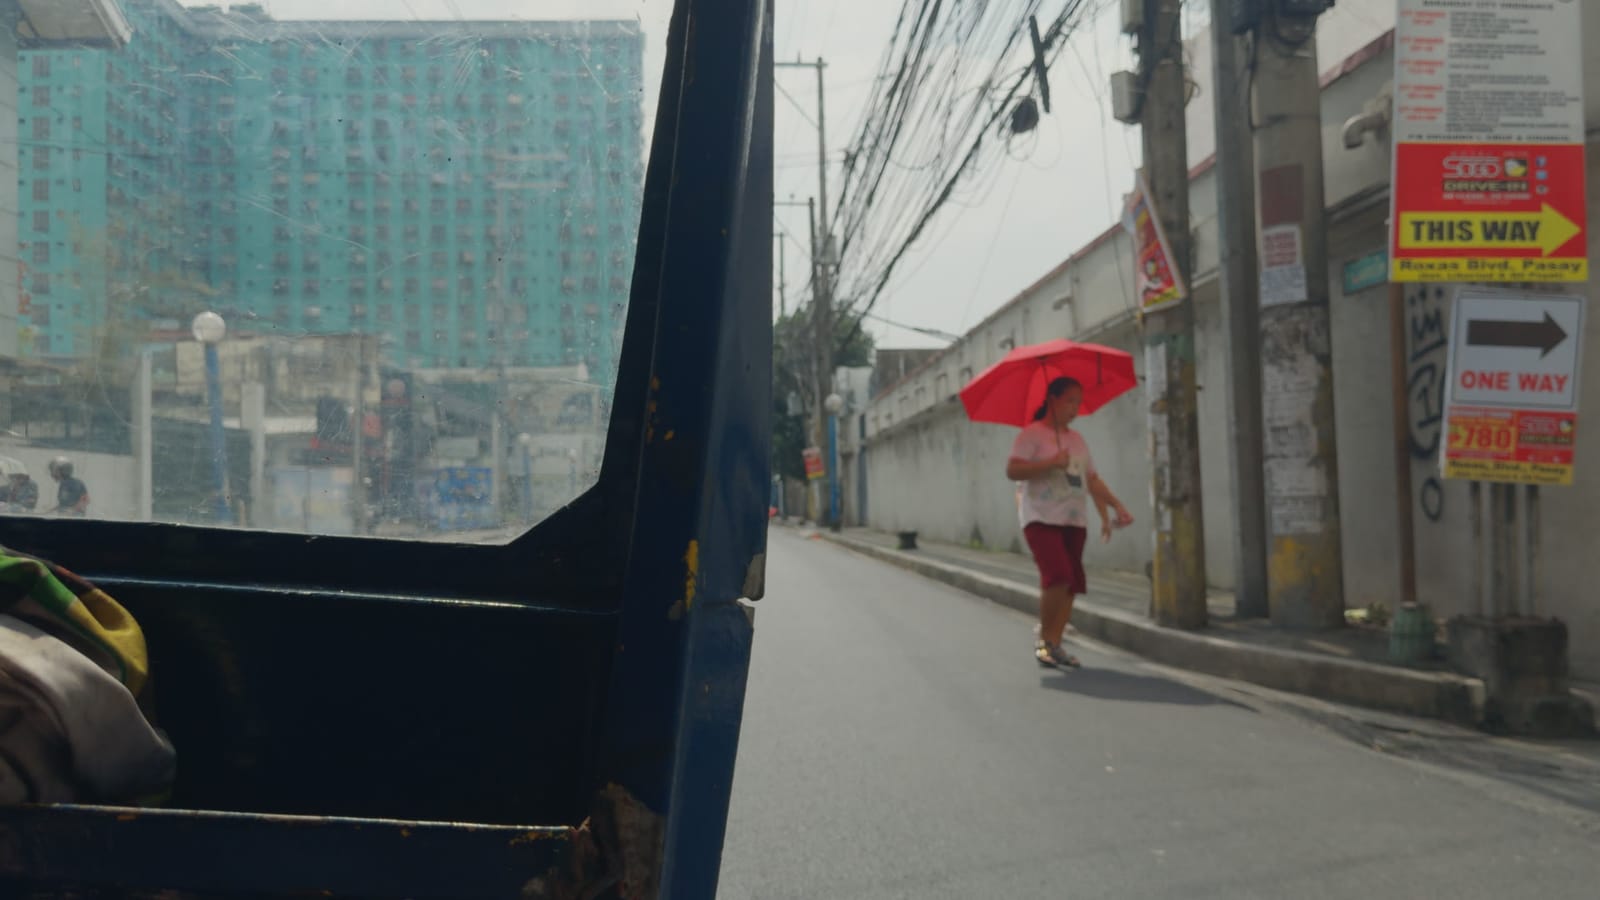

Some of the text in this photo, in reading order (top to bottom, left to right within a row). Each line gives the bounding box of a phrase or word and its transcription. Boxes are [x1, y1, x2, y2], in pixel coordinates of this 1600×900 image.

[1411, 220, 1541, 241] THIS WAY
[1460, 370, 1569, 394] ONE WAY
